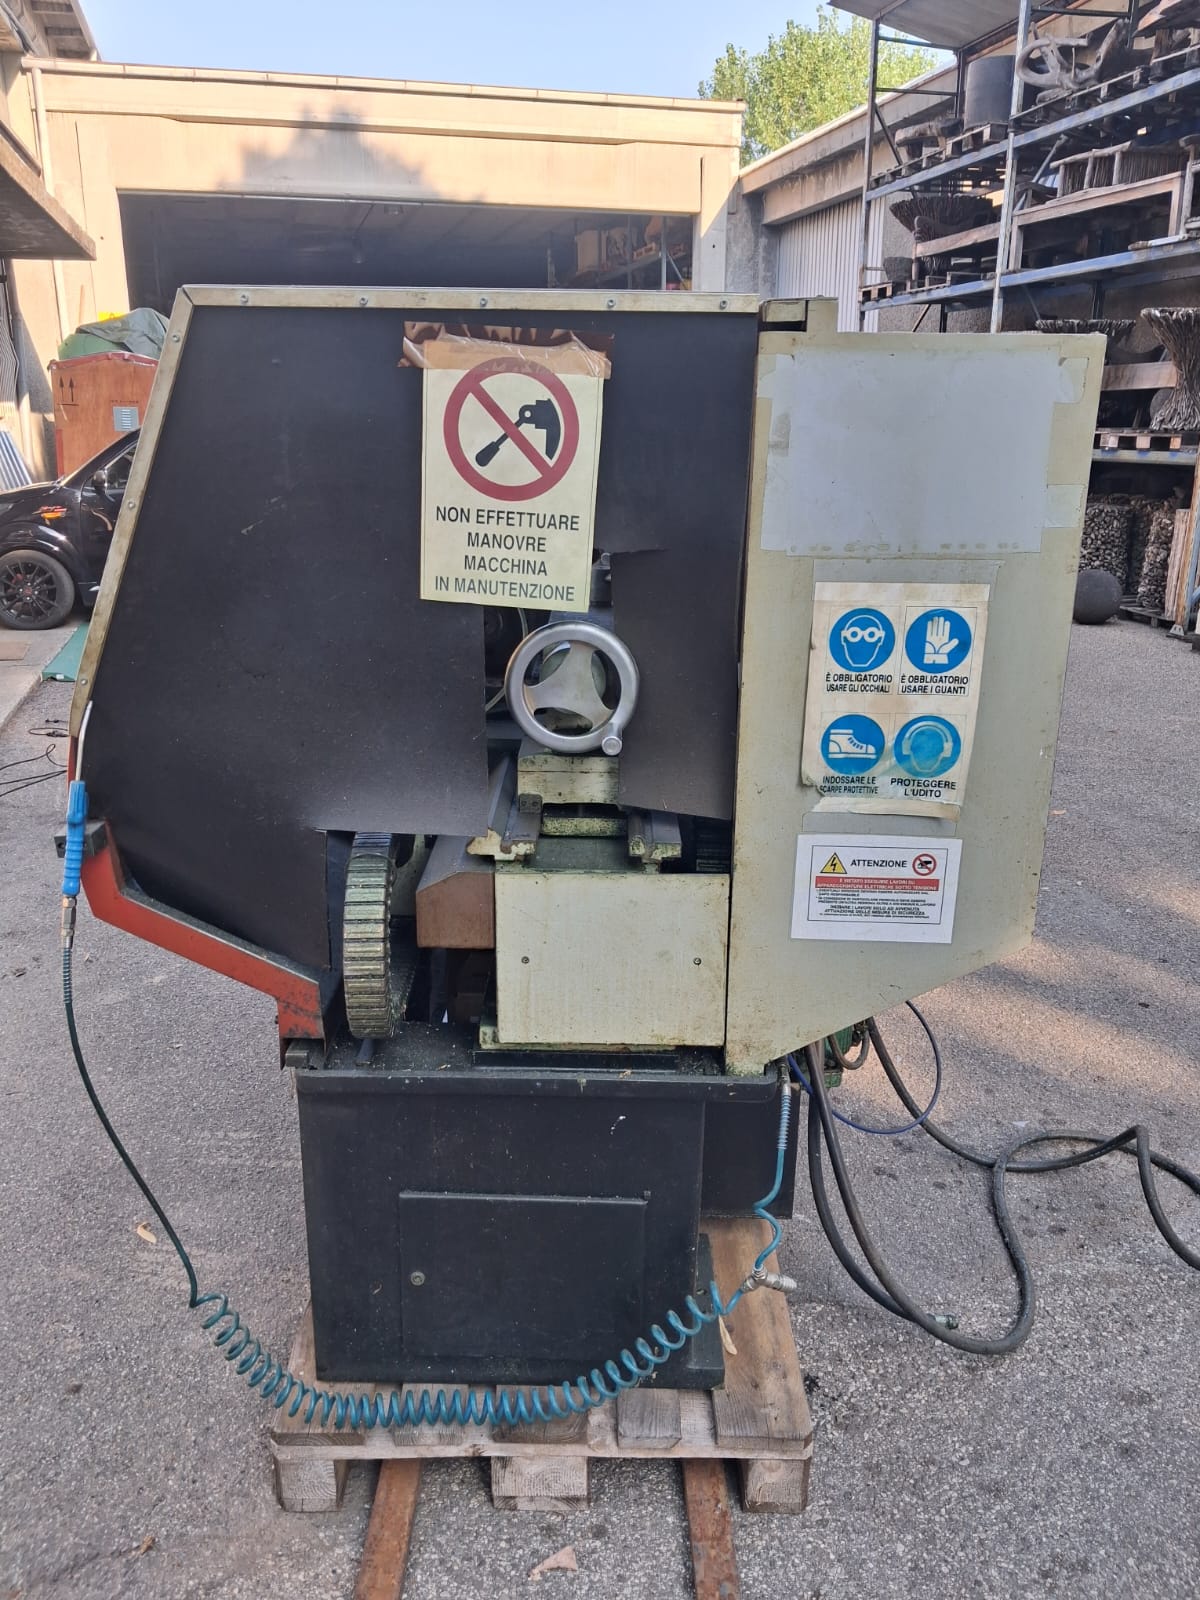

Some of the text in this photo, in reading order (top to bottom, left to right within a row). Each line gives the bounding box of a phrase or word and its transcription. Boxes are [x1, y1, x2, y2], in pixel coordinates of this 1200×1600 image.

[435, 505, 580, 531] NON EFFETTUARE
[467, 531, 547, 553] MANOVRE
[464, 554, 548, 577] MACCHINA
[435, 575, 575, 602] IN MANUTENZIONE
[825, 672, 893, 684] È OBBLIGATORIO
[900, 674, 969, 686] È OBBLIGATORIO
[826, 683, 891, 694] USARE GLI OCCHIALI
[901, 685, 928, 695] USARE
[935, 686, 966, 695] GUANTI
[822, 775, 877, 785] INDOSSARE LE
[890, 777, 957, 790] PROTEGGERE
[843, 785, 879, 795] PROTETTIVE
[904, 788, 942, 798] L'UDITO
[850, 859, 908, 869] ATTENZIONE
